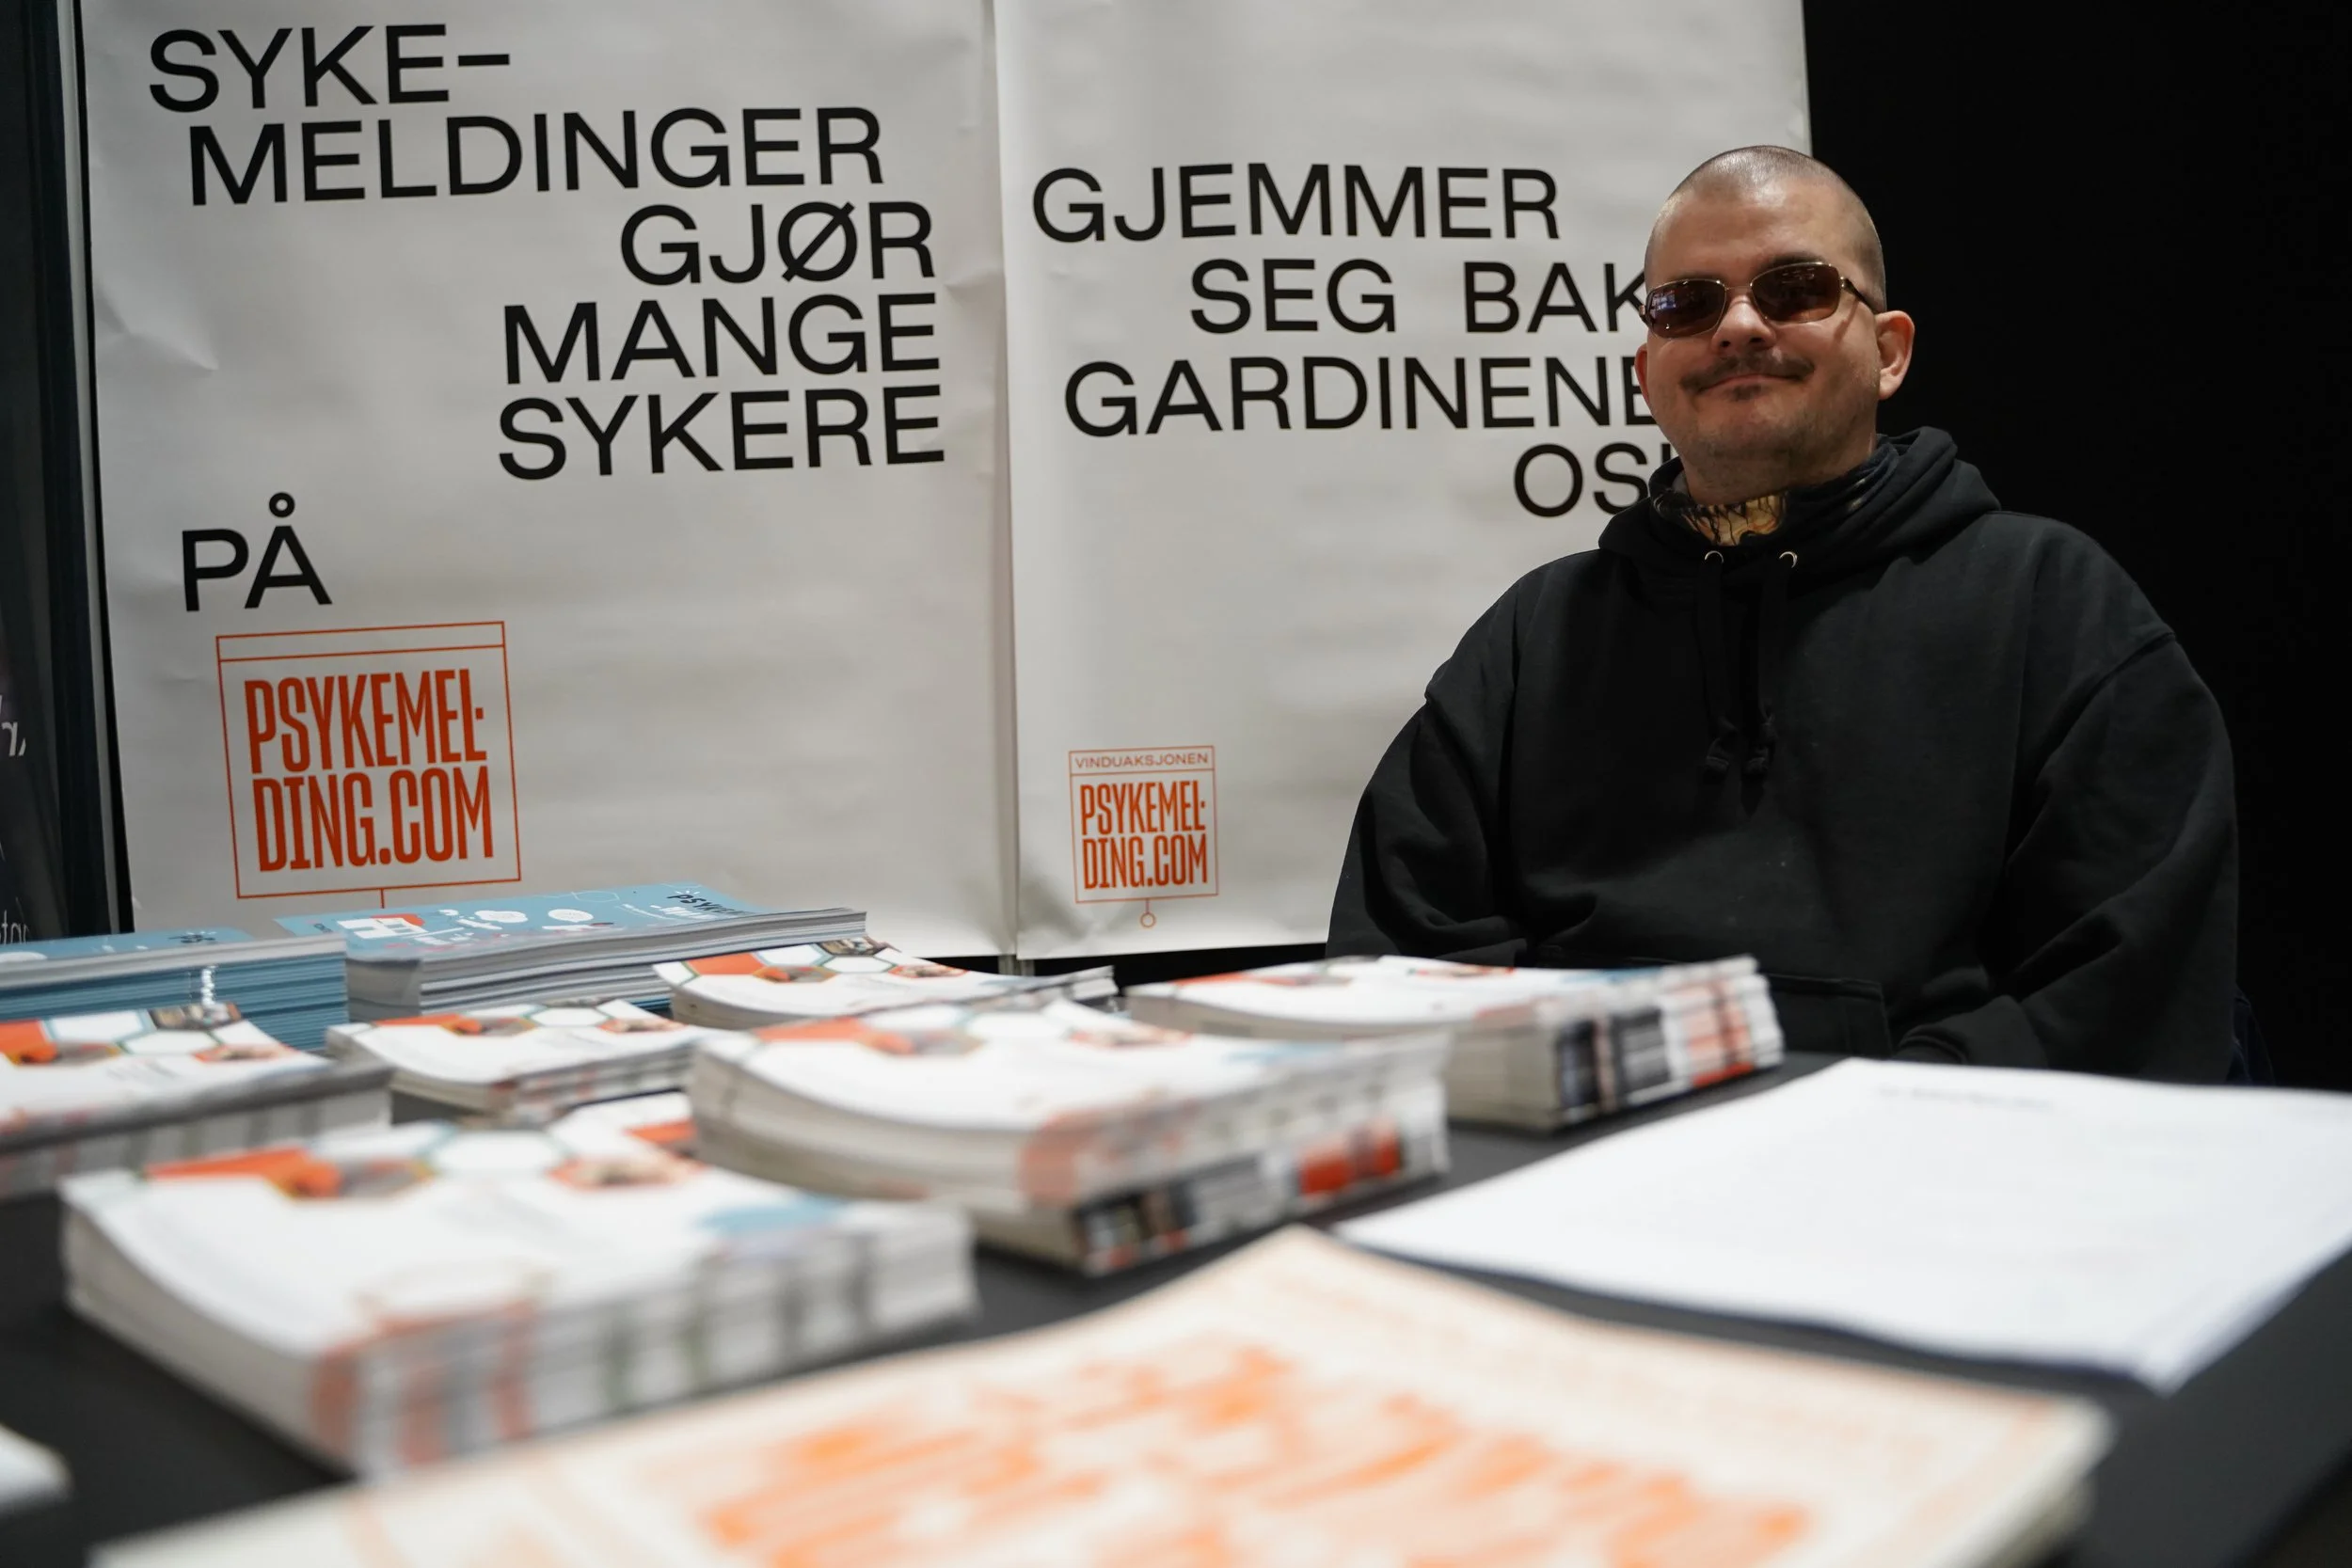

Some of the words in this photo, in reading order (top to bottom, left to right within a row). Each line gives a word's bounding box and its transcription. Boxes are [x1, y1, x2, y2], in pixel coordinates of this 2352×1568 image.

[148, 24, 511, 112] SYKE-
[189, 107, 884, 206] MELDINGER
[620, 201, 935, 285] GJØR
[1031, 163, 1560, 243] GJEMMER
[503, 292, 941, 385] MANGE
[1190, 259, 1396, 333] SEG
[1464, 261, 1646, 333] BAK
[498, 384, 946, 481] SYKERE
[1064, 356, 1659, 436] GARDINENE
[181, 492, 333, 612] PÅ
[1075, 752, 1208, 768] VINDUAKSJONEN
[252, 766, 494, 872] DING.COM
[1083, 833, 1208, 890] DING.COM
